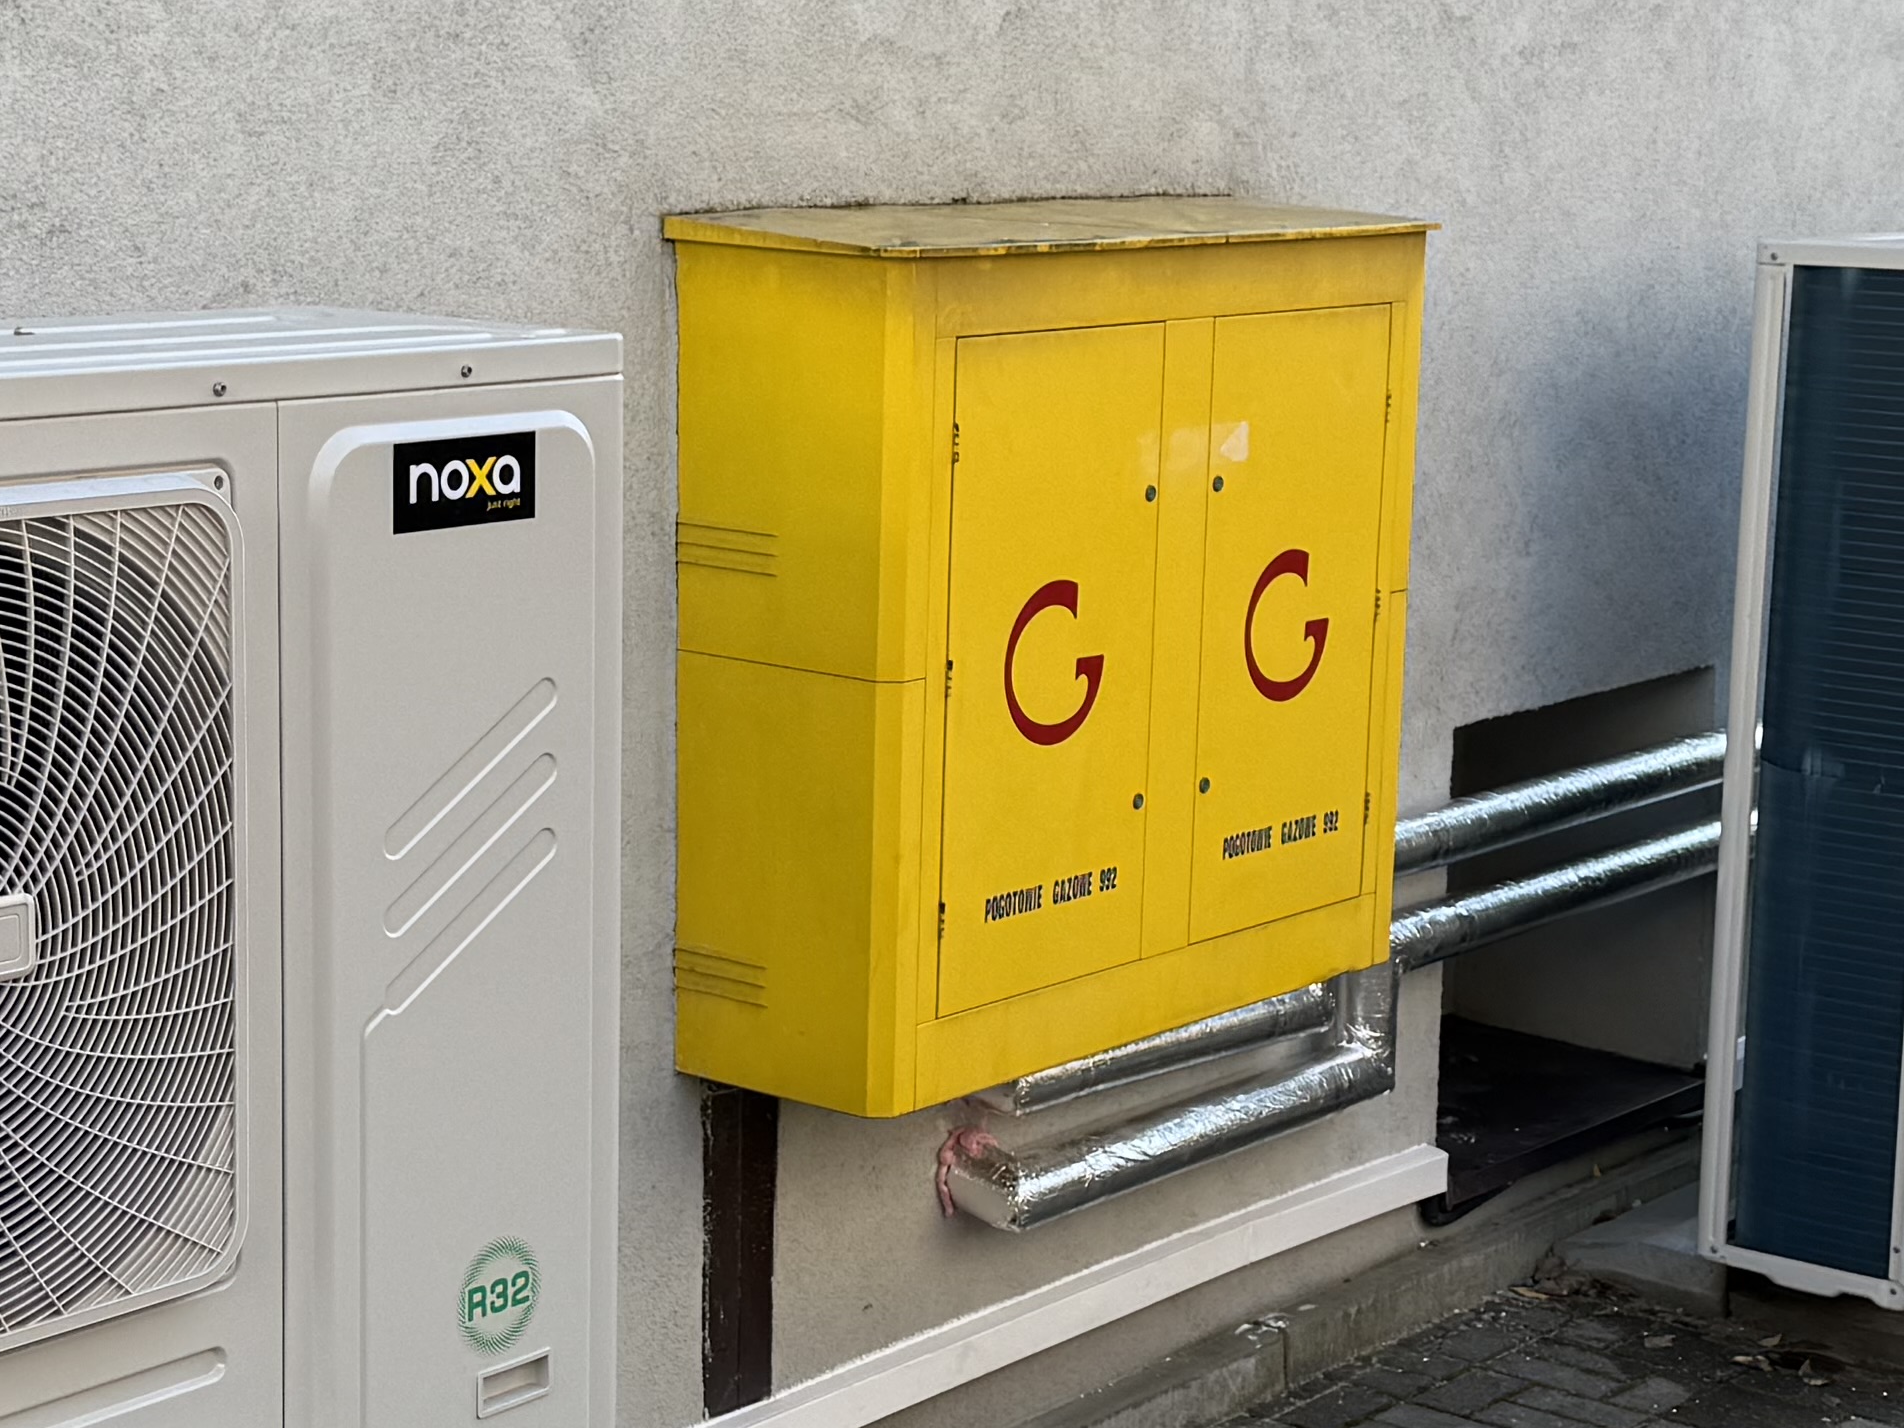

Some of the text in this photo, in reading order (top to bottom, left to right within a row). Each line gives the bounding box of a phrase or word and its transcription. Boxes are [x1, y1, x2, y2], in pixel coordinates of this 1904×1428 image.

[409, 454, 521, 504] noxa
[486, 497, 521, 511] just right
[1244, 548, 1329, 702] G
[1004, 579, 1104, 746] G
[1222, 809, 1339, 860] POGOTOWIE GAZOWE 992
[984, 866, 1118, 923] POGOTOWIE GAZOWE 992
[467, 1270, 530, 1322] R32
